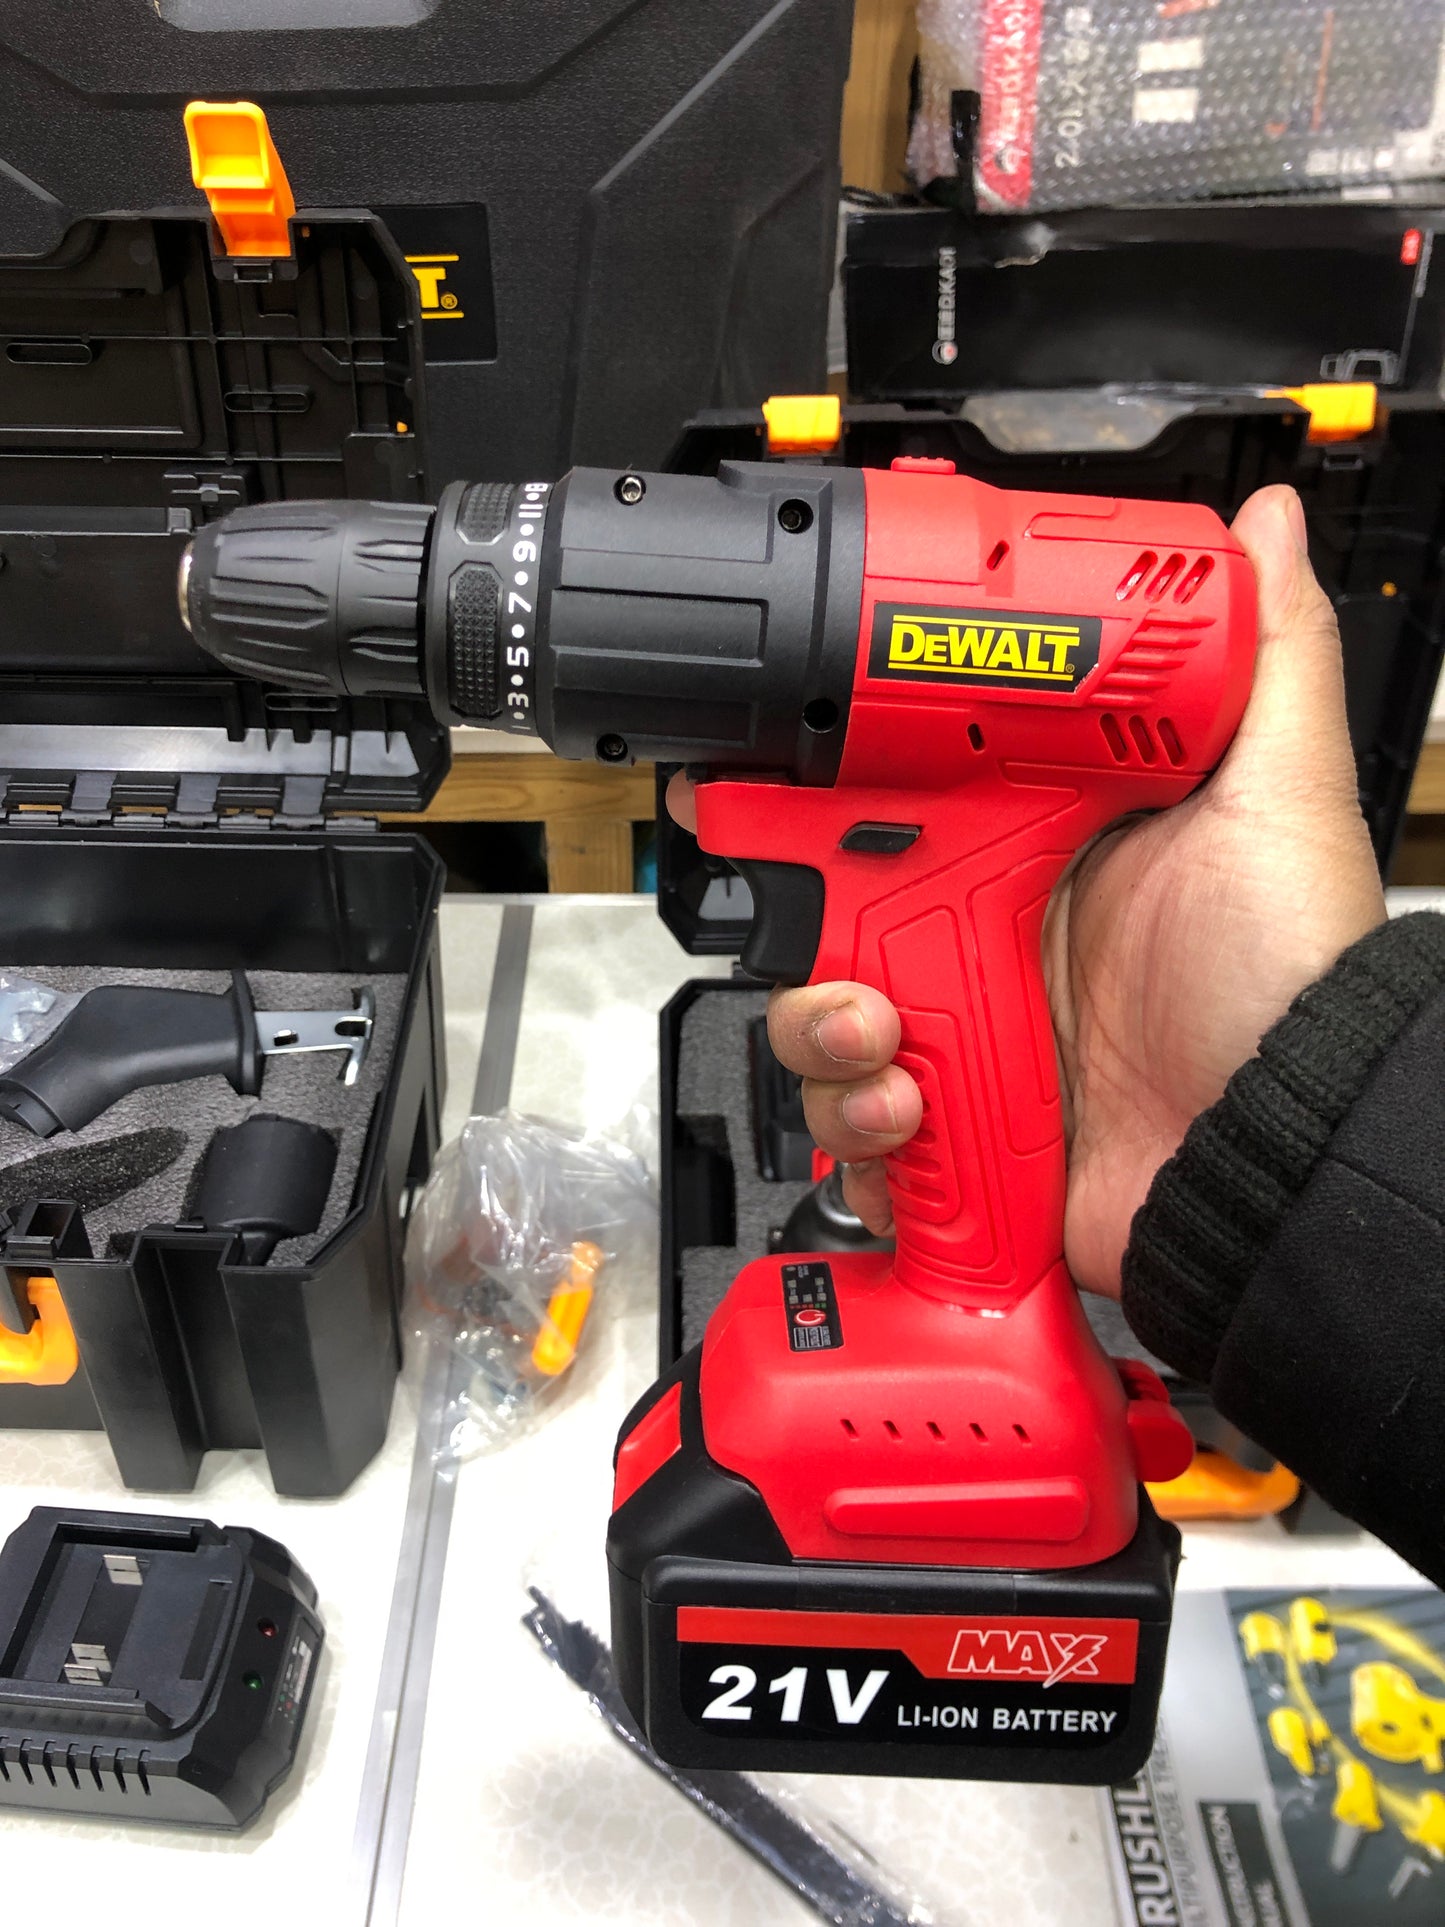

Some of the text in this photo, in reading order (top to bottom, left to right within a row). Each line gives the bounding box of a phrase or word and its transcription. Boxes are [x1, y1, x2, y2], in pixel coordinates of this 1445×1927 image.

[518, 503, 544, 519] 11
[512, 540, 537, 562] 9
[508, 592, 532, 614] 7
[506, 646, 529, 668] 5
[507, 692, 529, 708] 3
[947, 1630, 1108, 1689] MAX
[897, 1705, 978, 1729] LI-ION
[992, 1707, 1117, 1733] BATTERY
[1114, 1772, 1178, 1926] RUSHL
